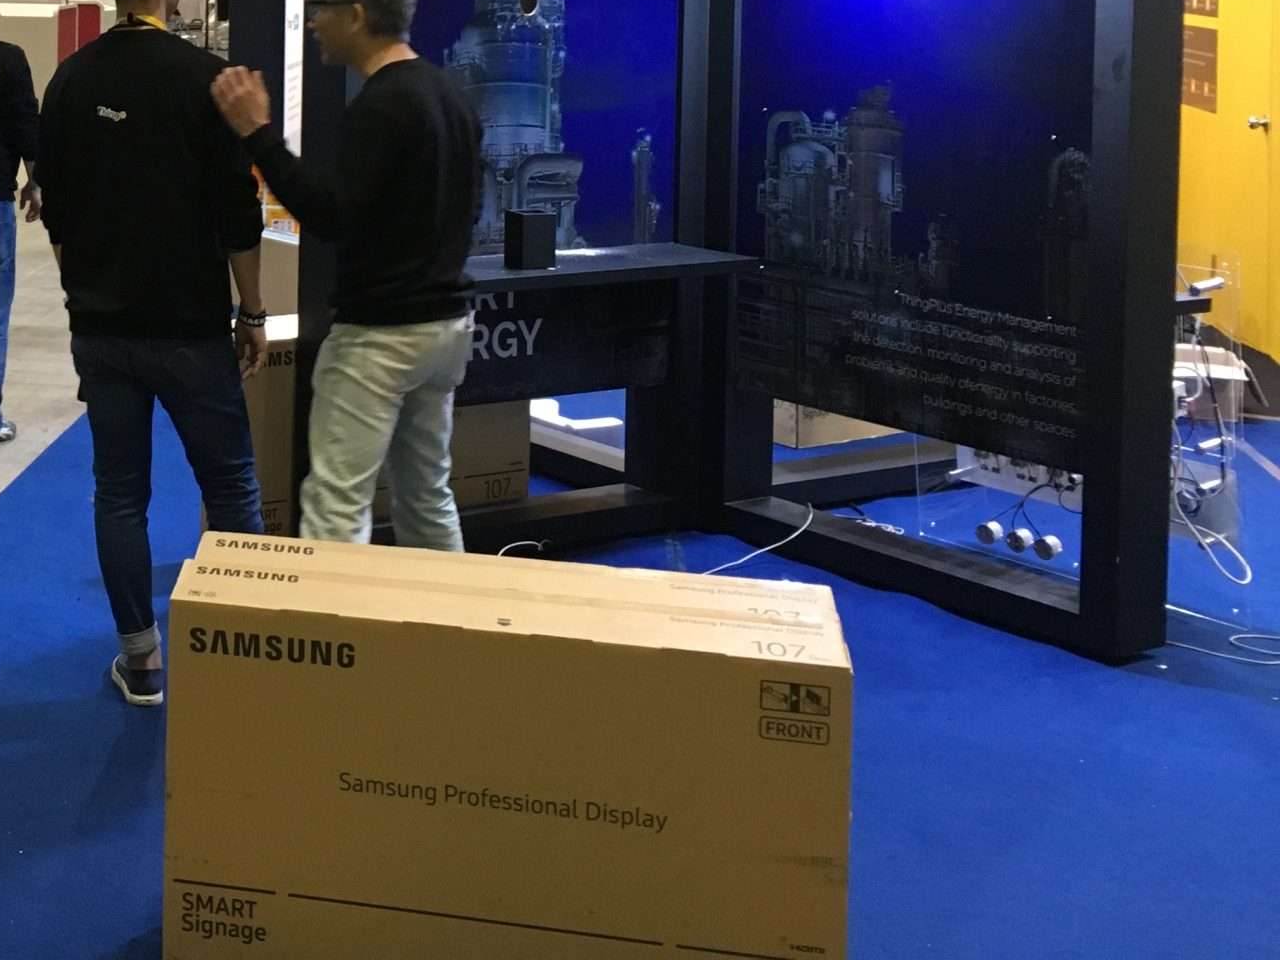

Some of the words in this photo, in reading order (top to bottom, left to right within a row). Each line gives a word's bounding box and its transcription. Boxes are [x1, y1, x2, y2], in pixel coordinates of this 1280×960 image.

[899, 293, 953, 315] ThingPlus
[955, 303, 997, 325] Energy
[998, 311, 1078, 338] Management
[852, 309, 898, 328] solutions
[900, 316, 941, 335] include
[942, 324, 1010, 352] functionality
[1012, 341, 1077, 365] supporting
[853, 330, 871, 345] the
[927, 348, 987, 372] monitoring
[989, 359, 1012, 375] and
[1014, 366, 1062, 385] analysis
[1063, 375, 1077, 388] of
[919, 369, 956, 388] quality
[1011, 390, 1022, 401] in
[923, 393, 973, 417] buildings
[975, 406, 998, 421] and
[999, 411, 1031, 428] other
[1033, 419, 1078, 439] spaces
[483, 478, 512, 500] 107
[215, 539, 315, 556] SAMSUNG
[196, 566, 300, 583] SAMSUNG
[189, 626, 356, 669] SAMSUNG
[750, 640, 806, 658] 107
[766, 721, 824, 741] FRONT
[338, 771, 437, 806] Samsung
[445, 783, 579, 820] Professional
[586, 798, 668, 834] Display
[181, 892, 258, 920] SMART
[181, 913, 267, 944] Signage
